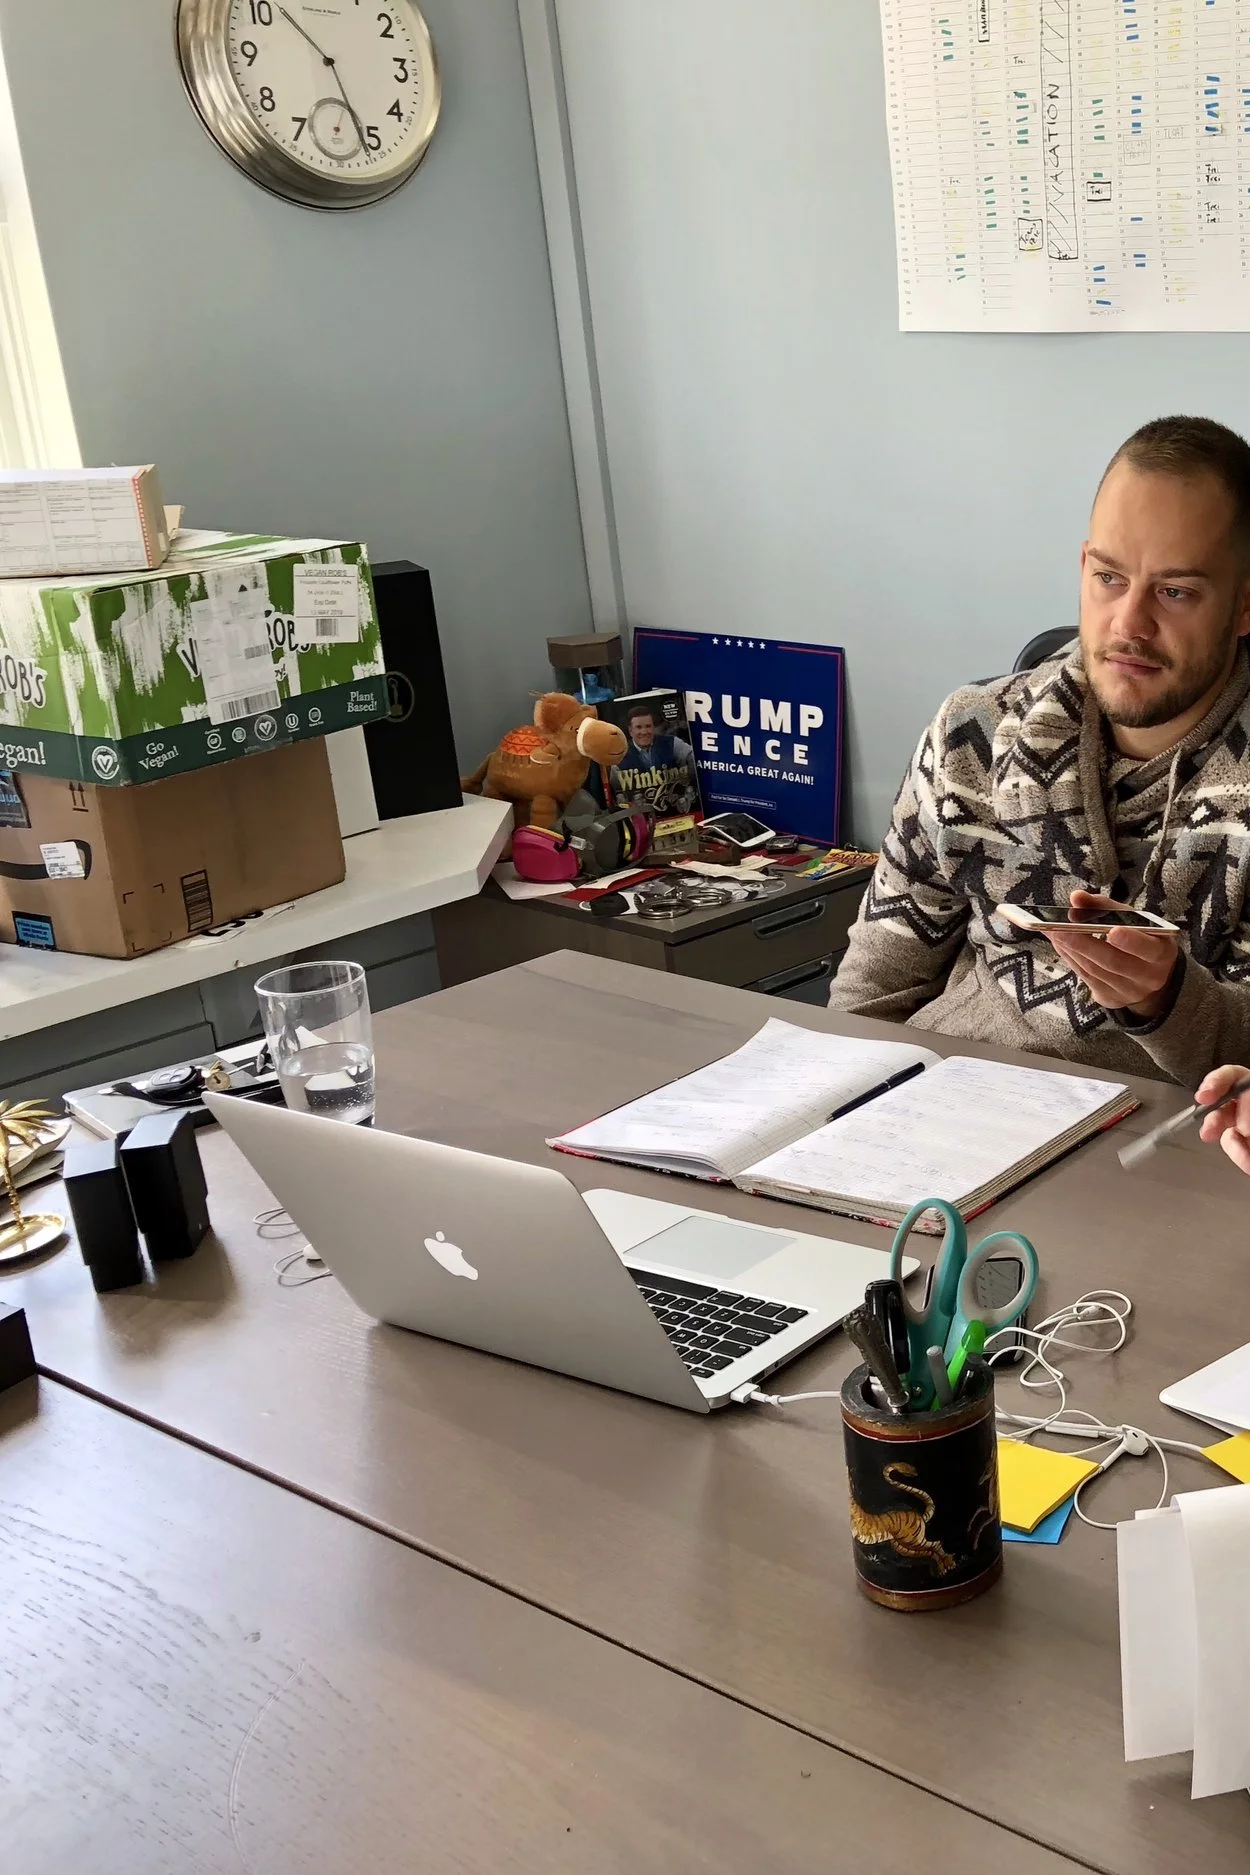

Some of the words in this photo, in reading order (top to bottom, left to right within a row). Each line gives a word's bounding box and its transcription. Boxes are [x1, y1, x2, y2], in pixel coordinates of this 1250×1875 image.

[251, 0, 272, 26] 10
[377, 13, 394, 39] 2
[240, 41, 257, 66] 9
[393, 58, 408, 83] 3
[259, 86, 275, 112] 8
[387, 99, 403, 122] 4
[291, 116, 307, 141] 7
[366, 126, 381, 151] 5
[1046, 83, 1065, 203] VACATION
[347, 701, 378, 713] Based!
[350, 691, 375, 702] Plant
[684, 690, 824, 737] RUMP
[138, 746, 180, 770] Vegan!
[145, 742, 165, 755] Go
[701, 731, 809, 766] ENCE
[617, 763, 688, 792] Winking
[697, 760, 744, 774] AMERICA
[747, 766, 779, 779] GREAT
[782, 771, 814, 785] AGAIN!
